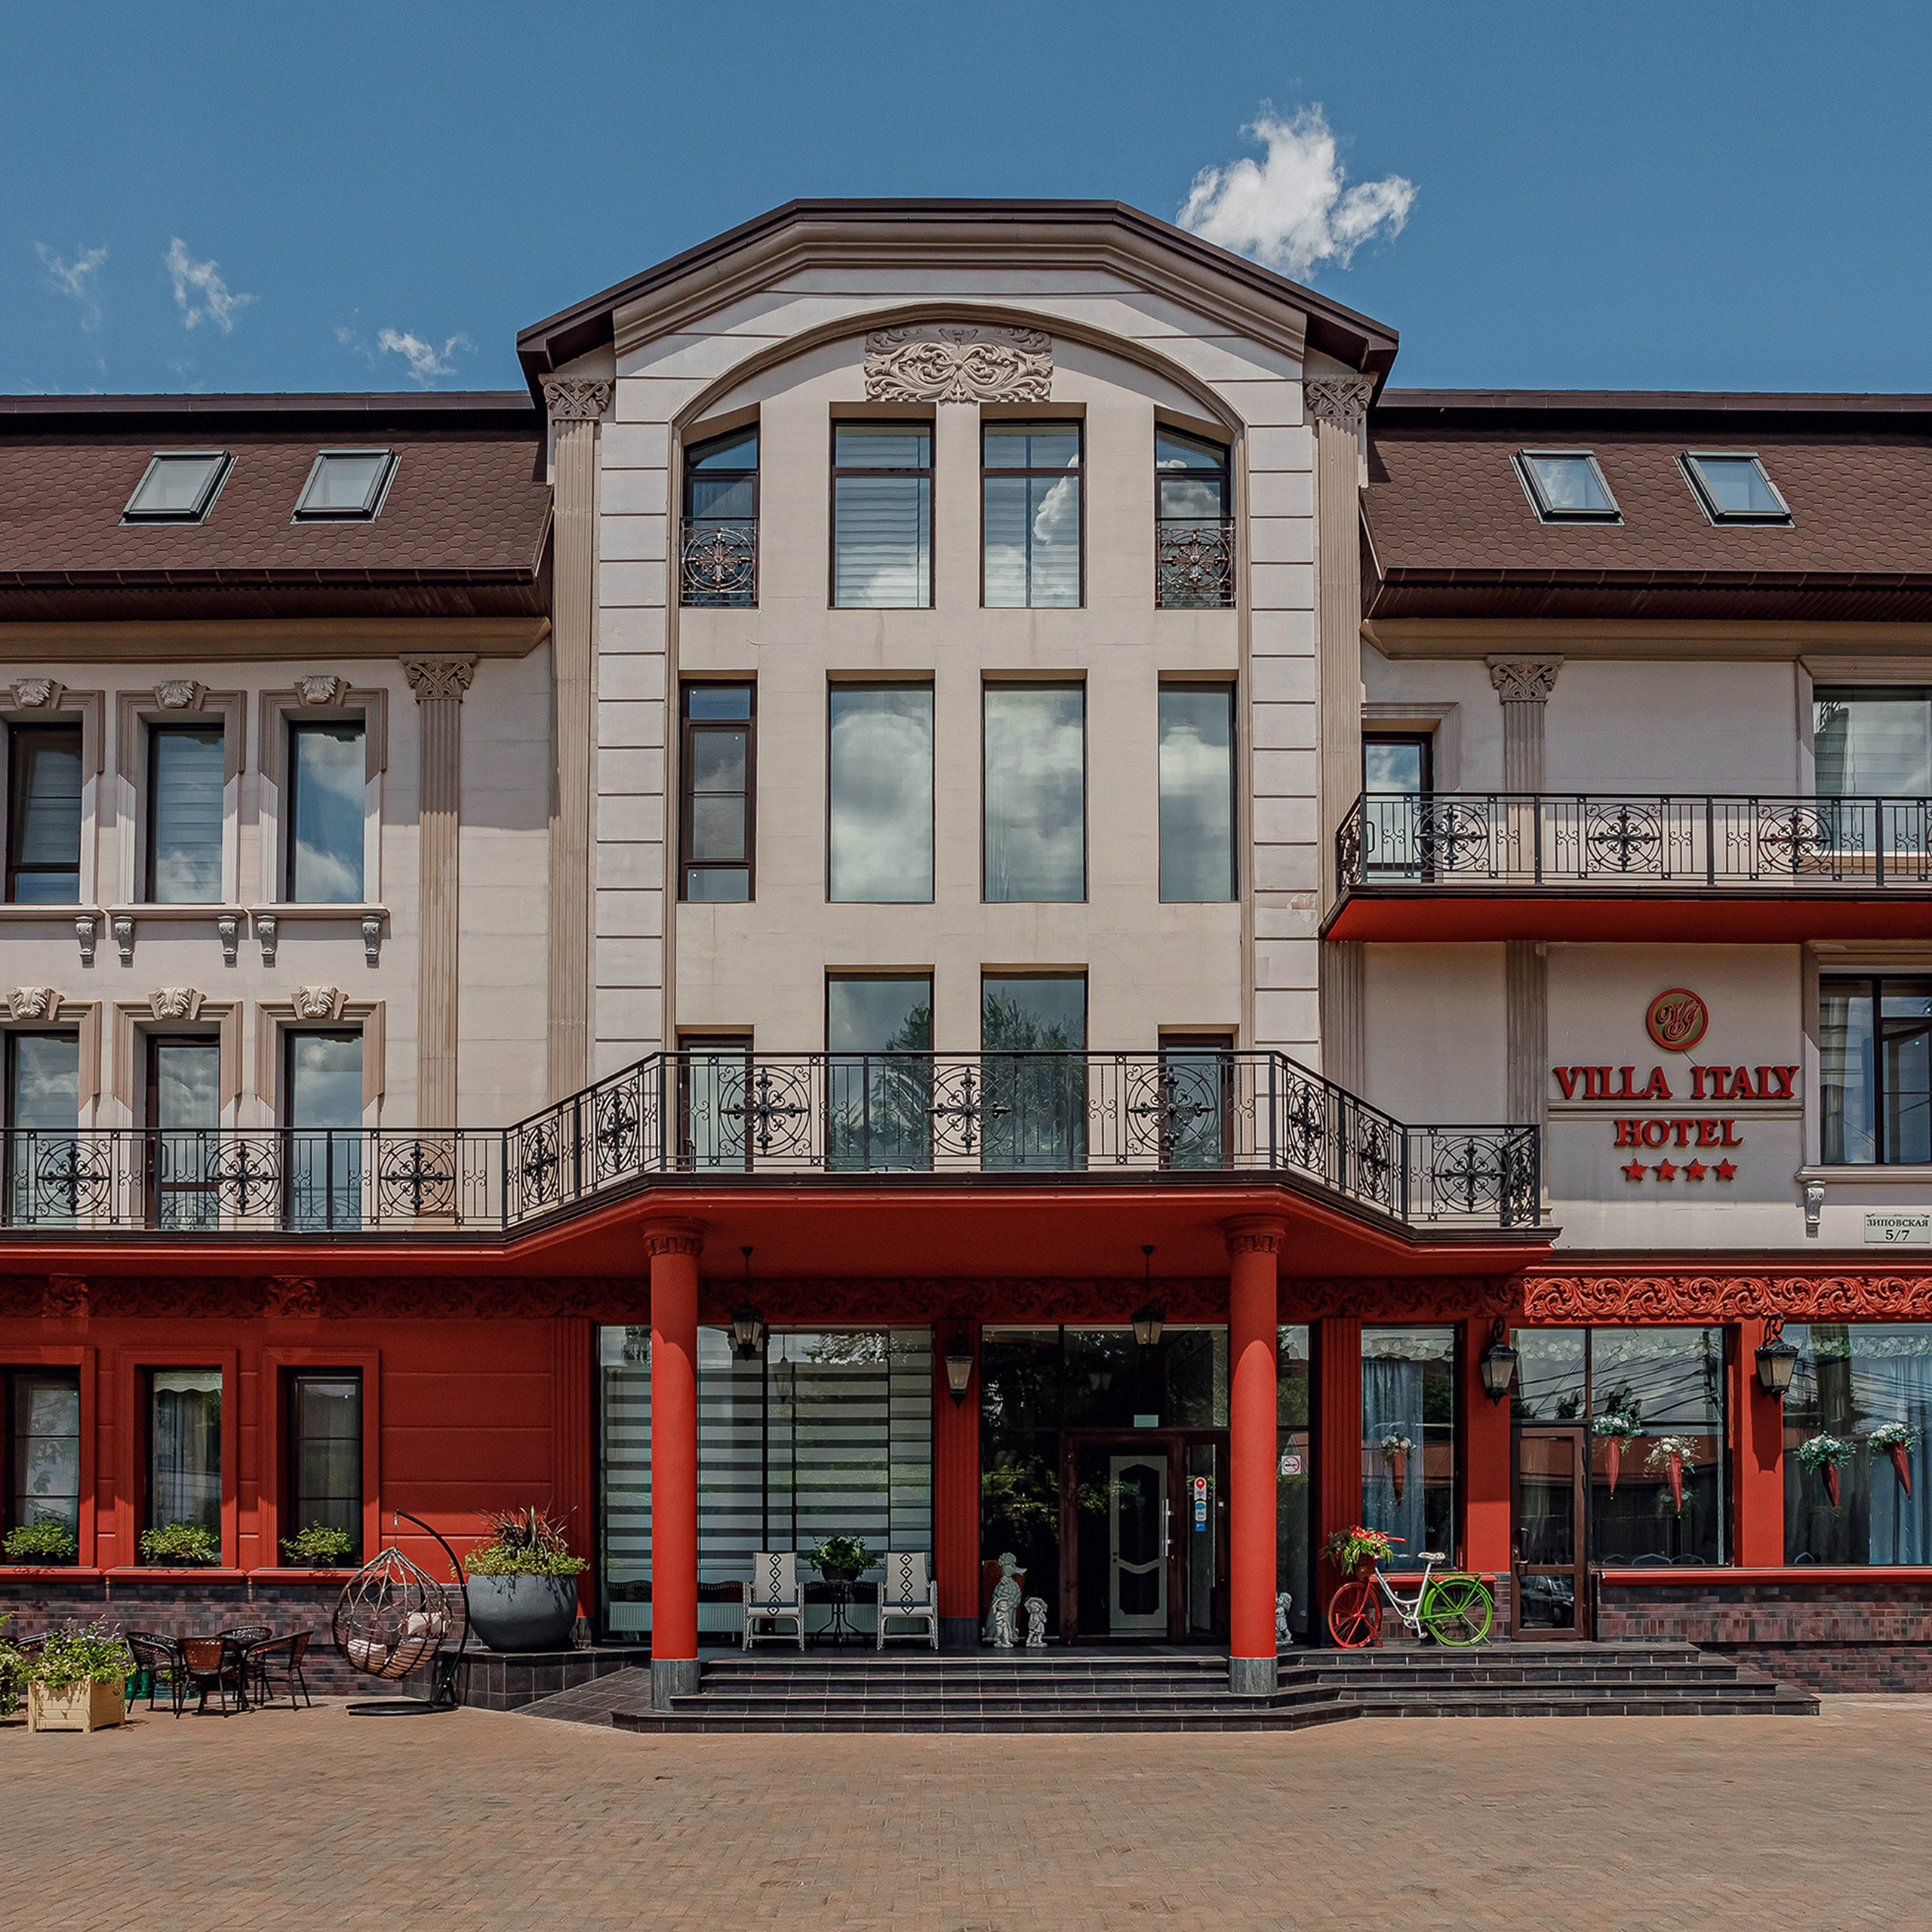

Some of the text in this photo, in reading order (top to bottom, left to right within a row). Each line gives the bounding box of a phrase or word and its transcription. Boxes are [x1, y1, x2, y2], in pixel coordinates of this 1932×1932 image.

[1552, 1066, 1800, 1100] VILLA ITALY
[1614, 1119, 1743, 1146] HOTEL
[1866, 1219, 1928, 1227] ЗИПОВСКАЯ
[1885, 1229, 1909, 1241] 5/7
